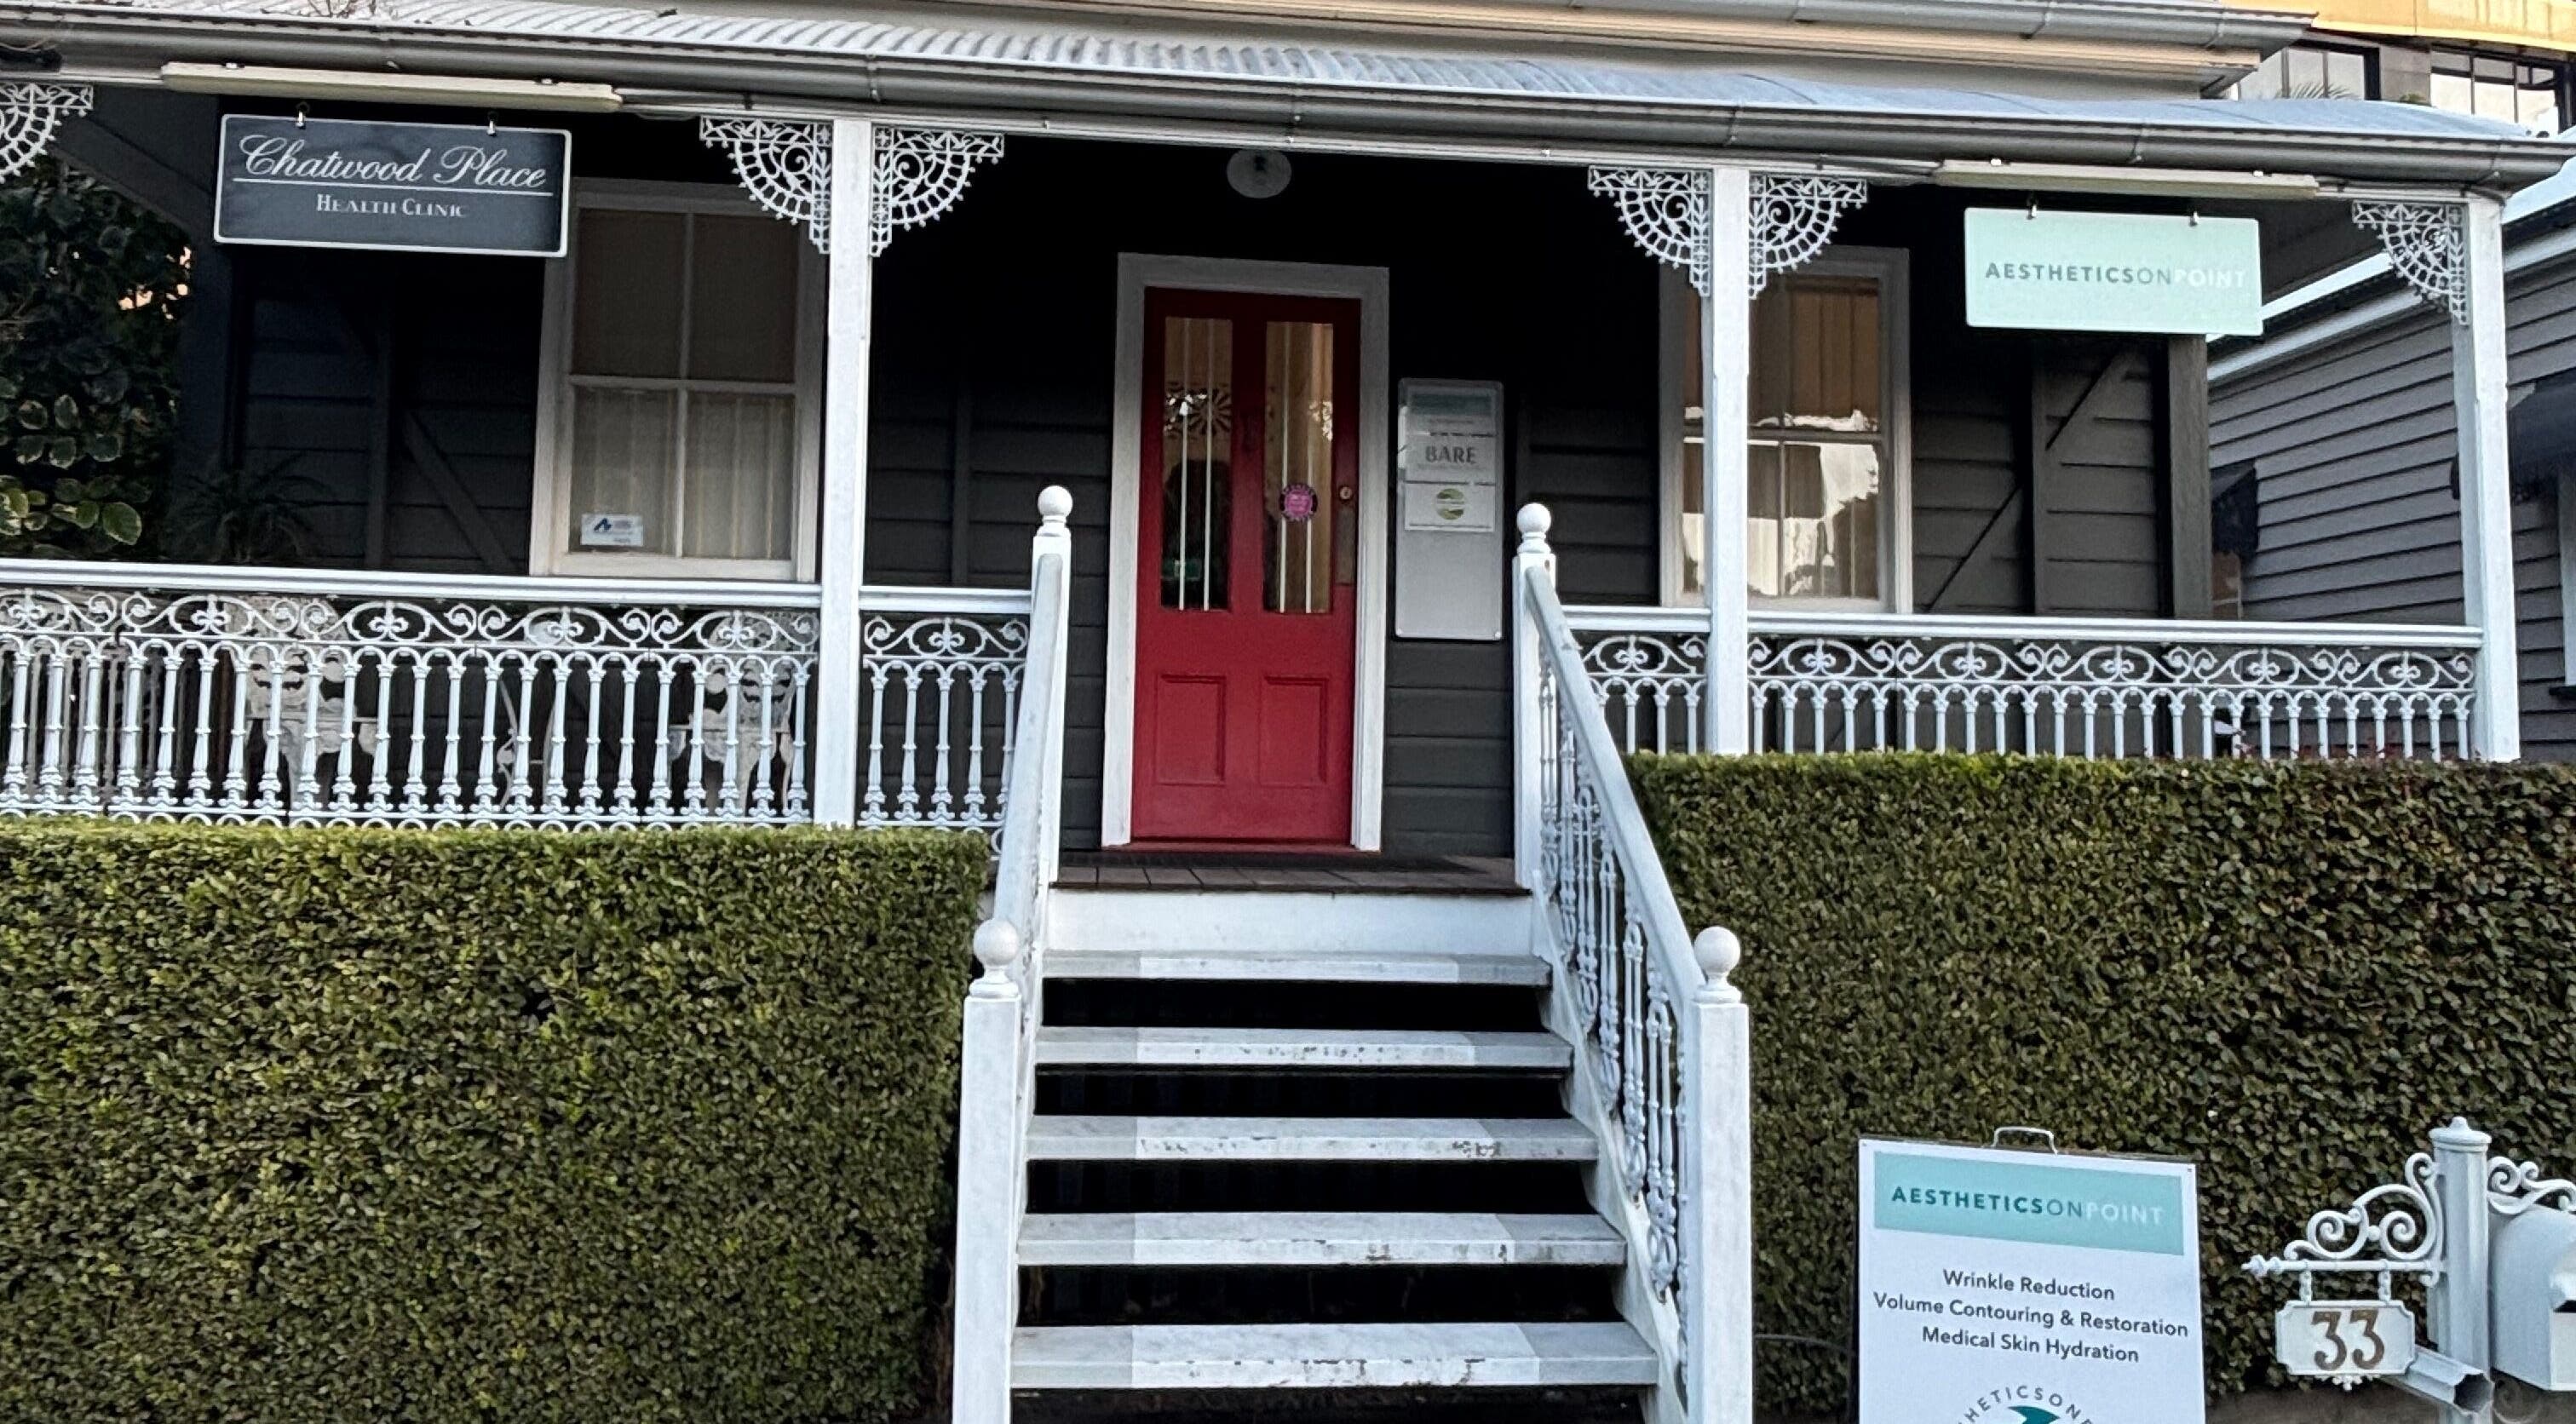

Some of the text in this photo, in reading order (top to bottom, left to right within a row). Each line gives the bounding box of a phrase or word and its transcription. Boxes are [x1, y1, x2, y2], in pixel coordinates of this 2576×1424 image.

[239, 134, 547, 188] Chatwood Place
[316, 193, 466, 218] HEALTH CLINIC
[1425, 445, 1476, 464] BARE
[1942, 1269, 2115, 1301] Wrinkle Reduction
[1873, 1291, 2188, 1337] Volume Contouring & Restoration
[1922, 1325, 2139, 1363] Medical Skin Hydration
[2310, 1308, 2385, 1371] 33
